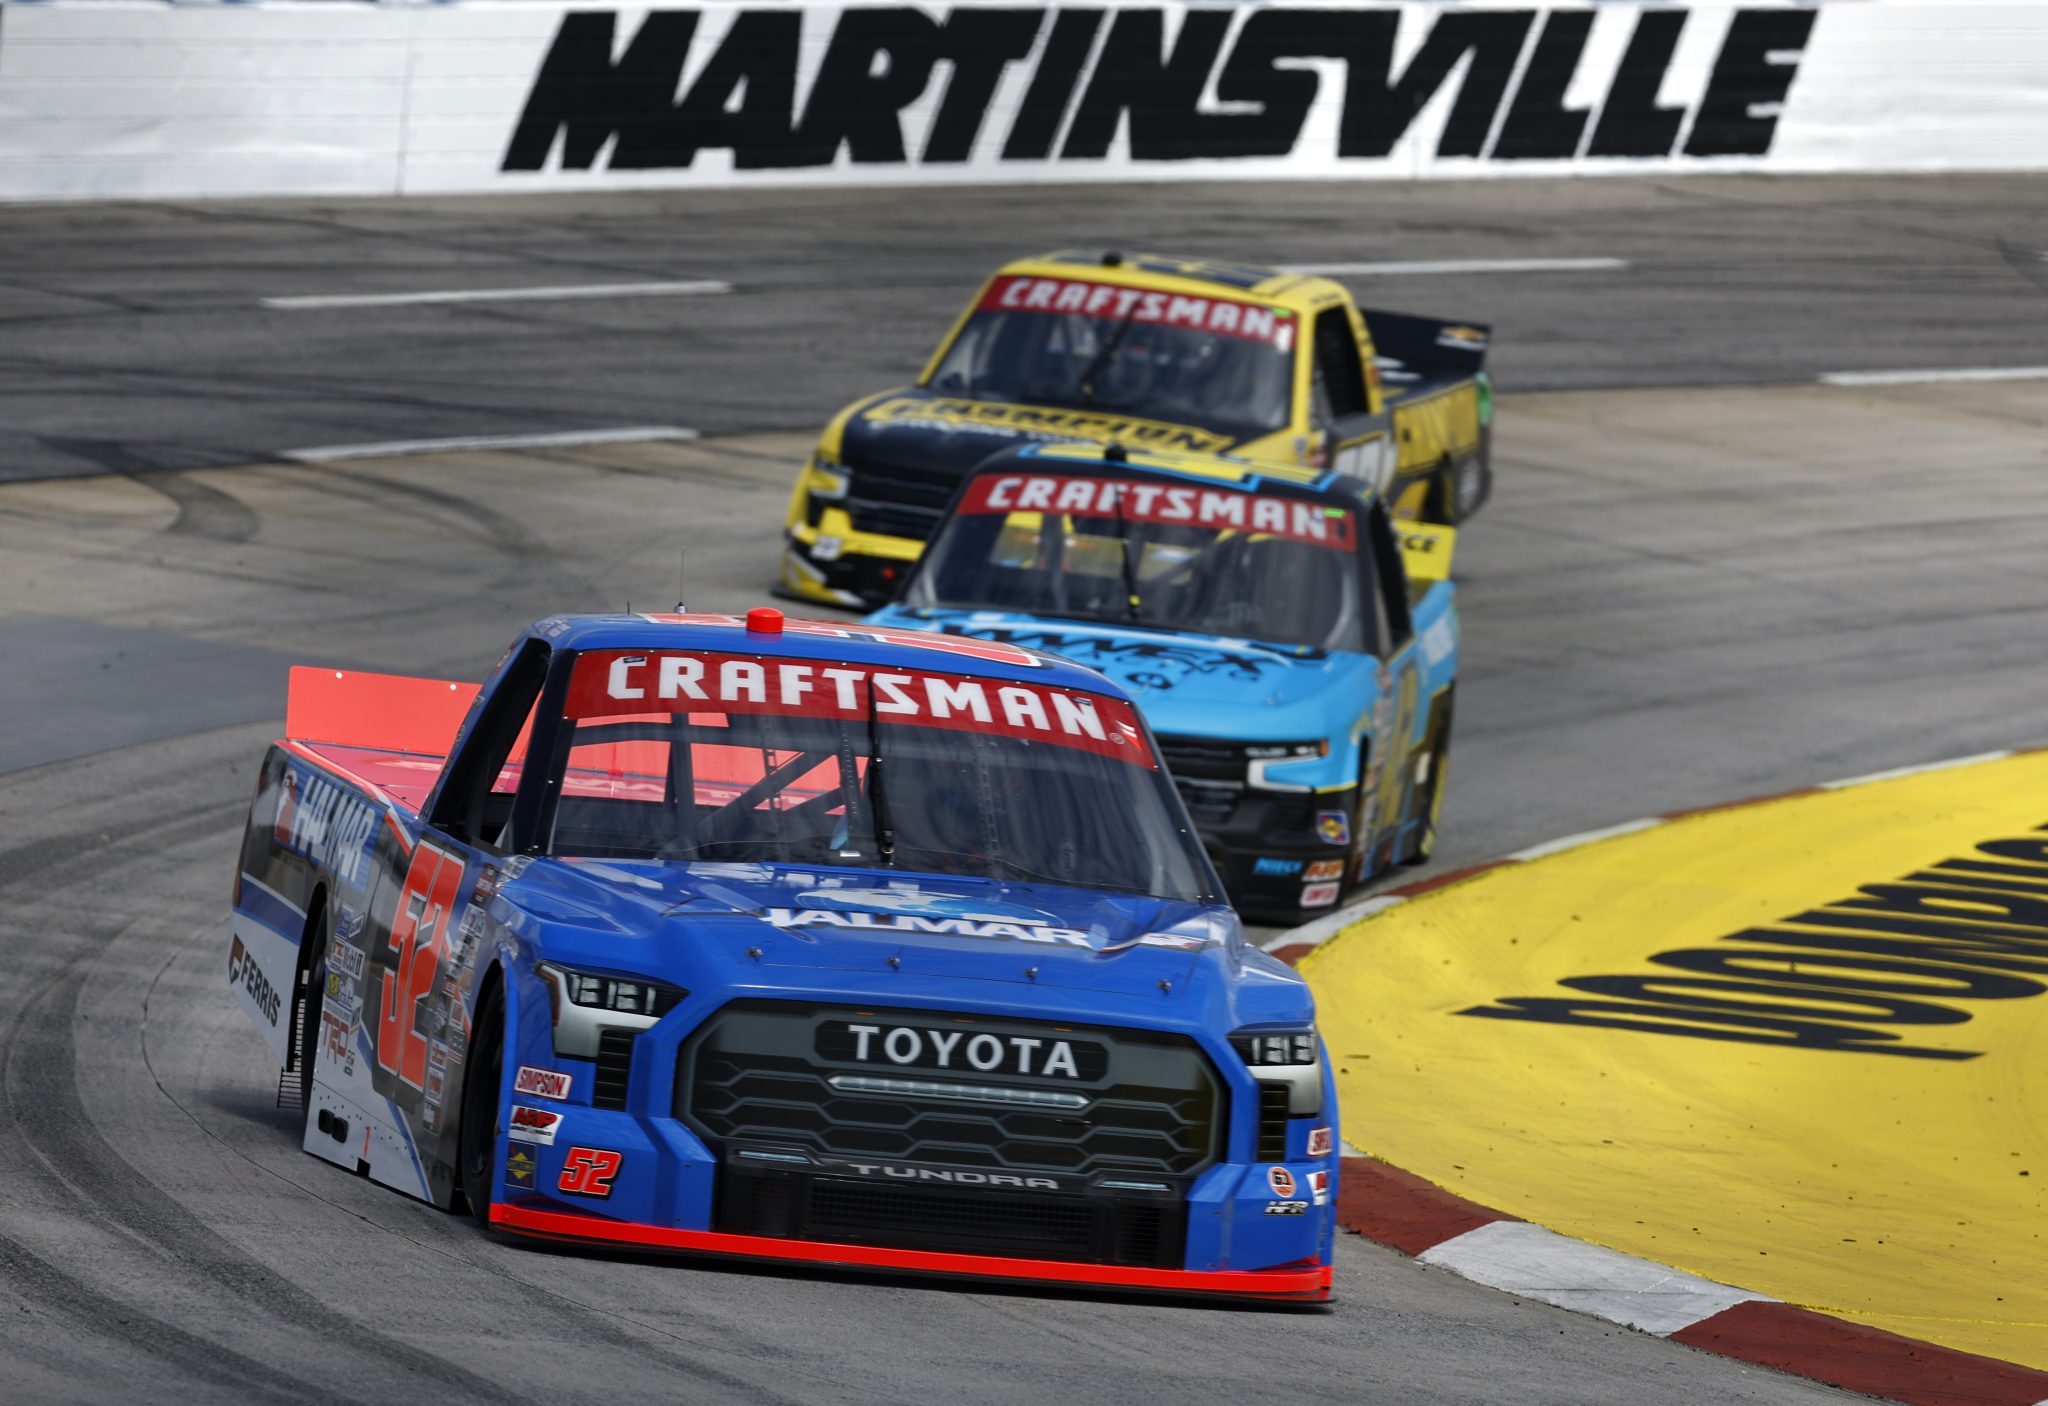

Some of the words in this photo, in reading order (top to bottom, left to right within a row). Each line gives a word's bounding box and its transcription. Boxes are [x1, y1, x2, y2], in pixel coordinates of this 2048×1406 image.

[499, 7, 1818, 172] MARTINSVILLE
[1001, 277, 1276, 338] CRAFTSMAN
[985, 476, 1327, 539] CRAFTSMAN
[607, 655, 1107, 741] CRAFTSMAN
[291, 775, 375, 882] HALMAR
[240, 951, 281, 1028] FERRIS
[377, 839, 466, 1093] 52
[322, 1010, 349, 1065] TRD
[848, 1024, 1080, 1078] TOYOTA
[518, 1068, 568, 1097] SIMPSON
[557, 1146, 623, 1197] 52
[847, 1163, 1059, 1190] TUNDRA
